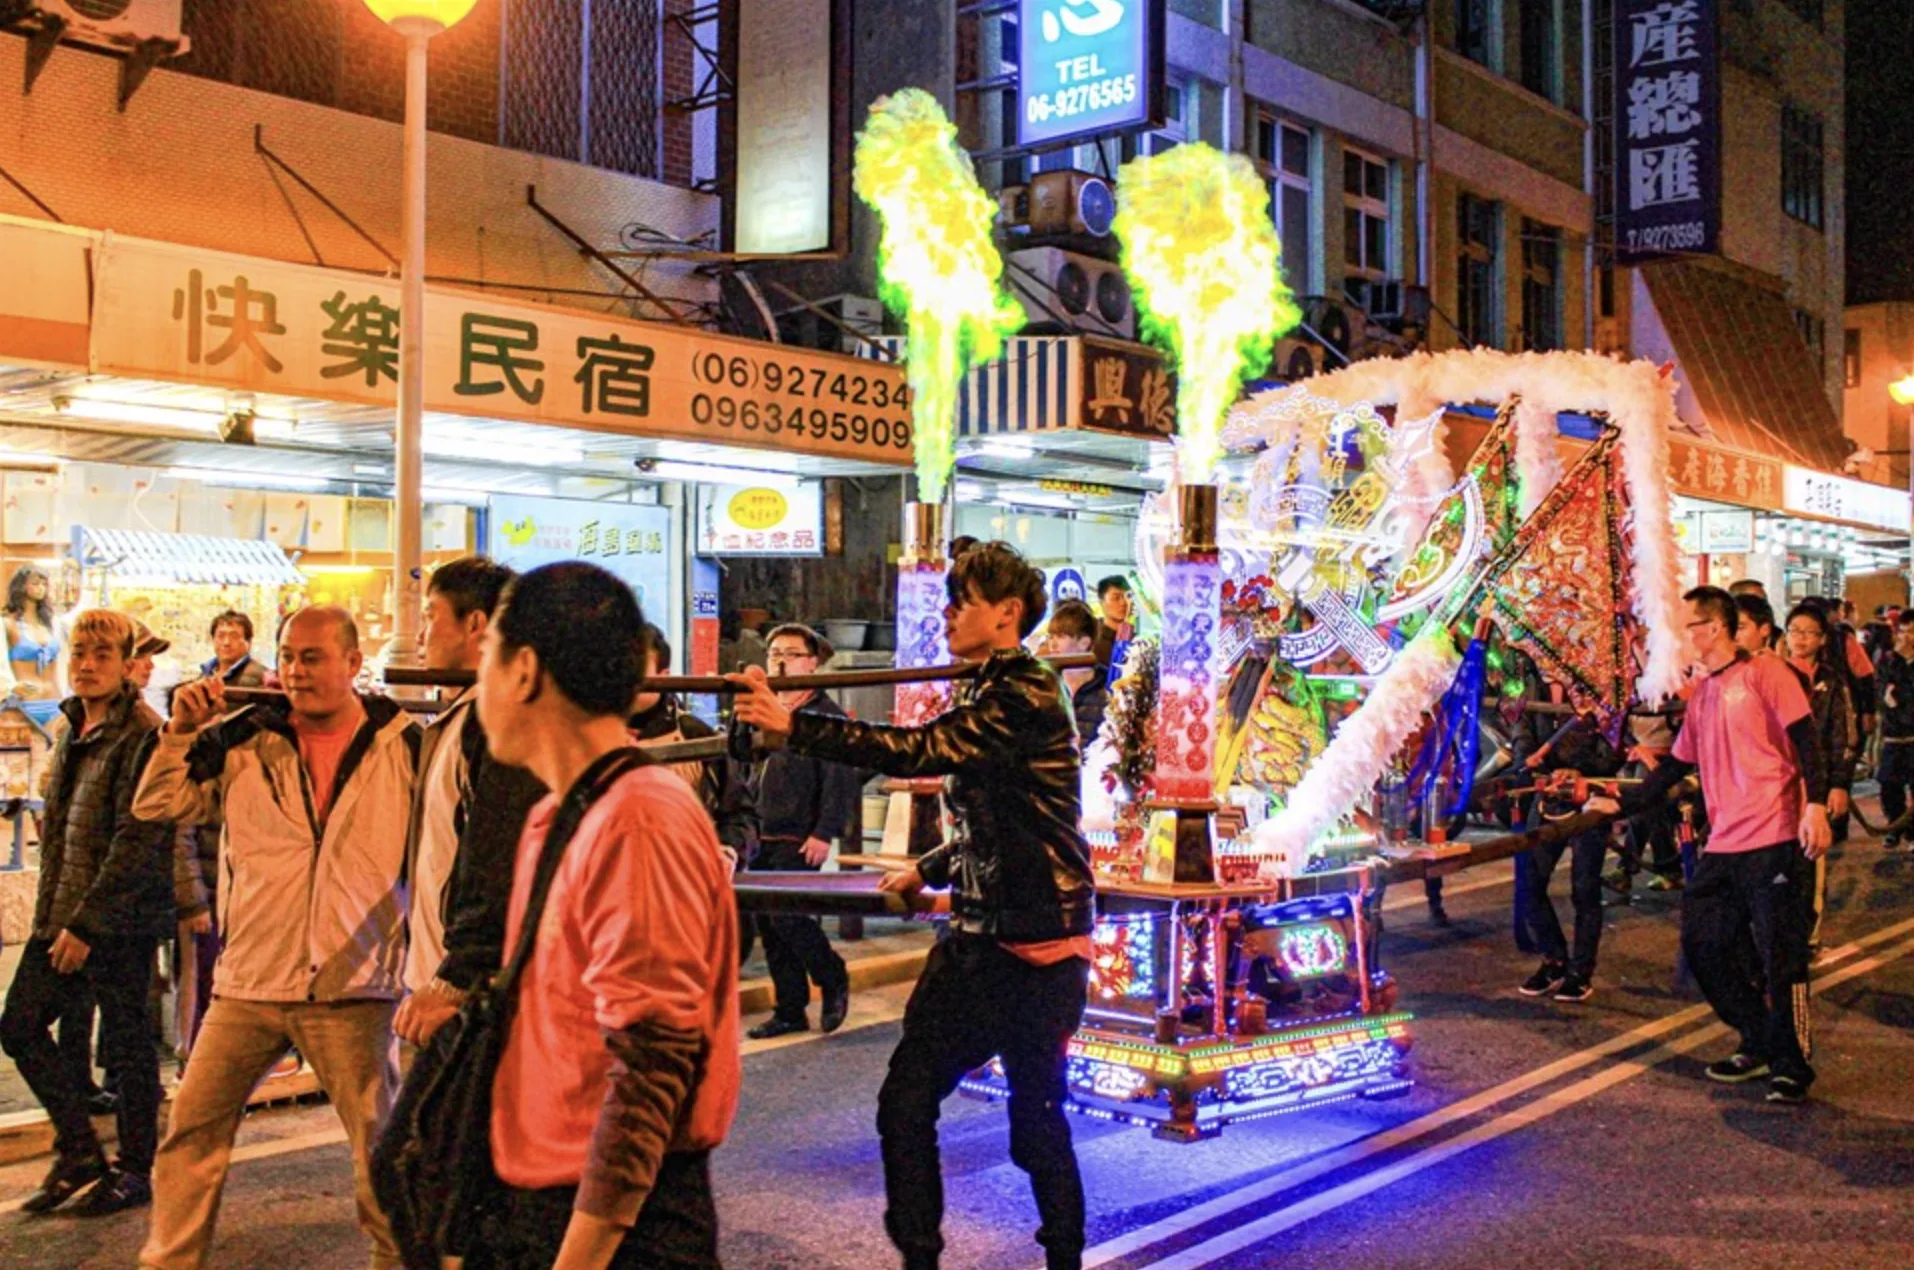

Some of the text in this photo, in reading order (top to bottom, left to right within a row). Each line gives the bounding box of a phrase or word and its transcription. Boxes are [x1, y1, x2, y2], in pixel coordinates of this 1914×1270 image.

[1055, 53, 1106, 84] TEL
[1027, 74, 1135, 123] 06-9276565
[172, 268, 655, 416] 快樂民宿
[692, 350, 908, 411] (06)9274234
[691, 393, 909, 449] 0963495909
